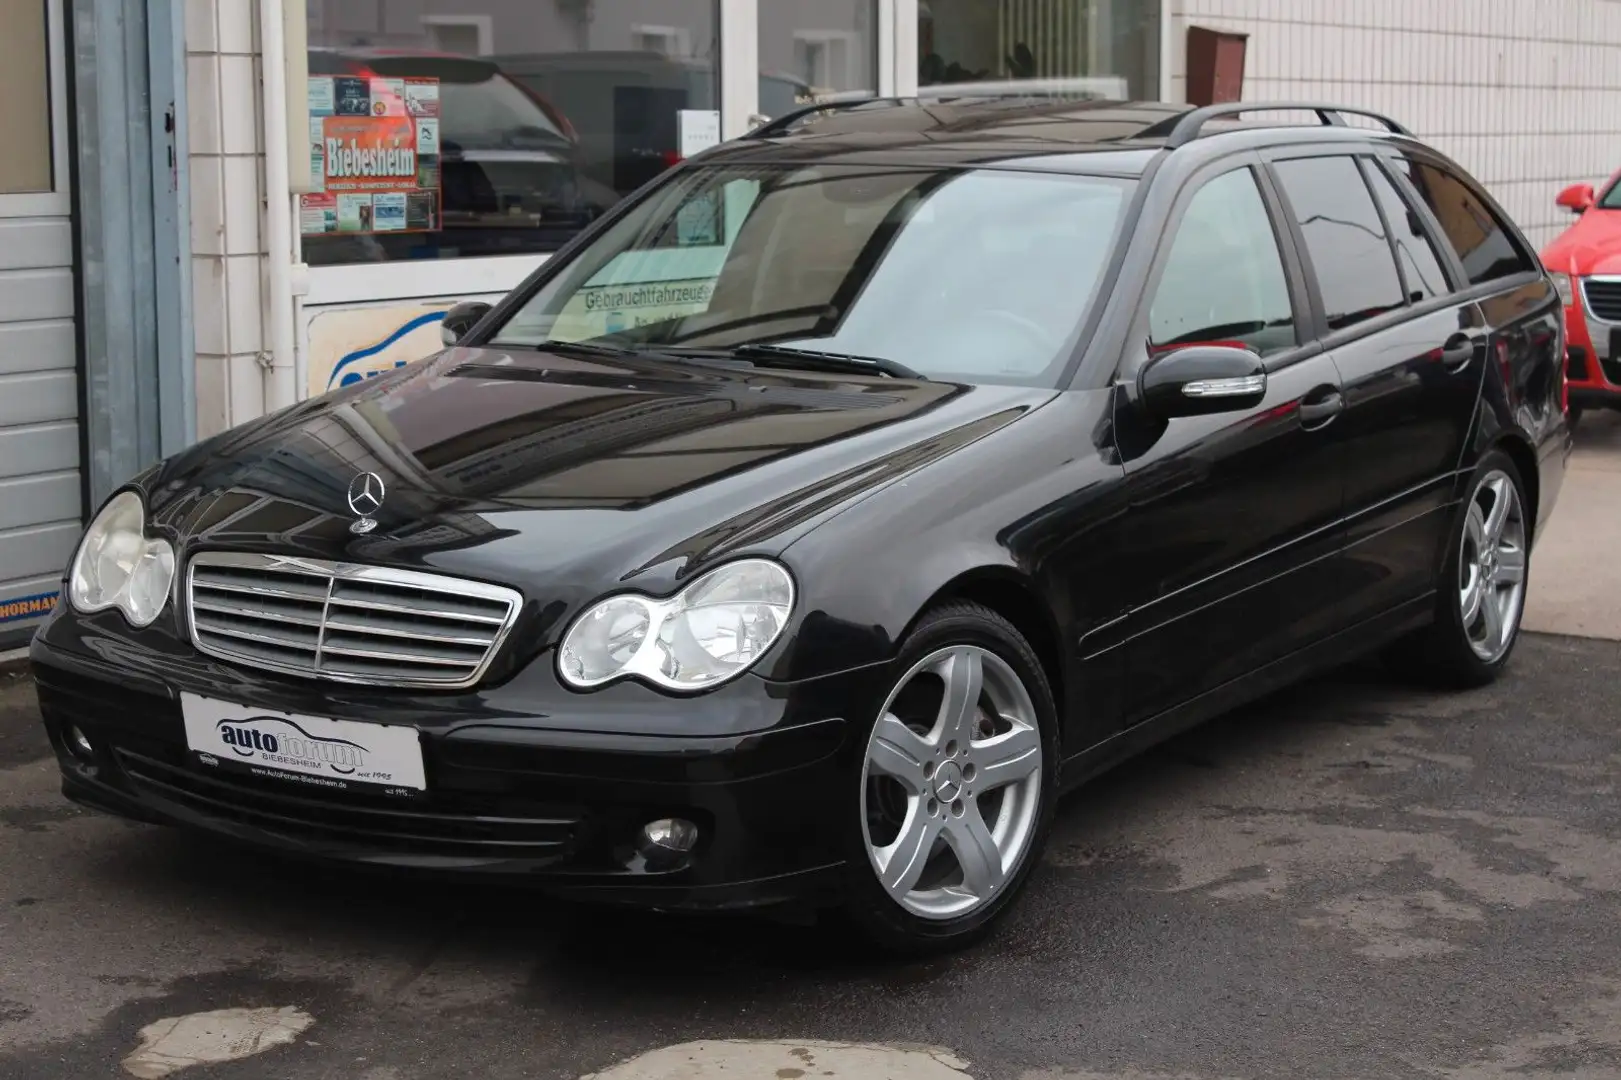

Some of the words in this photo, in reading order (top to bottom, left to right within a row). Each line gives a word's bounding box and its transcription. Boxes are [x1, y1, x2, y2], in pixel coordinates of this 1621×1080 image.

[326, 137, 415, 177] Biebesheim
[261, 752, 322, 769] BIEBESHEIM
[372, 771, 392, 781] 1995
